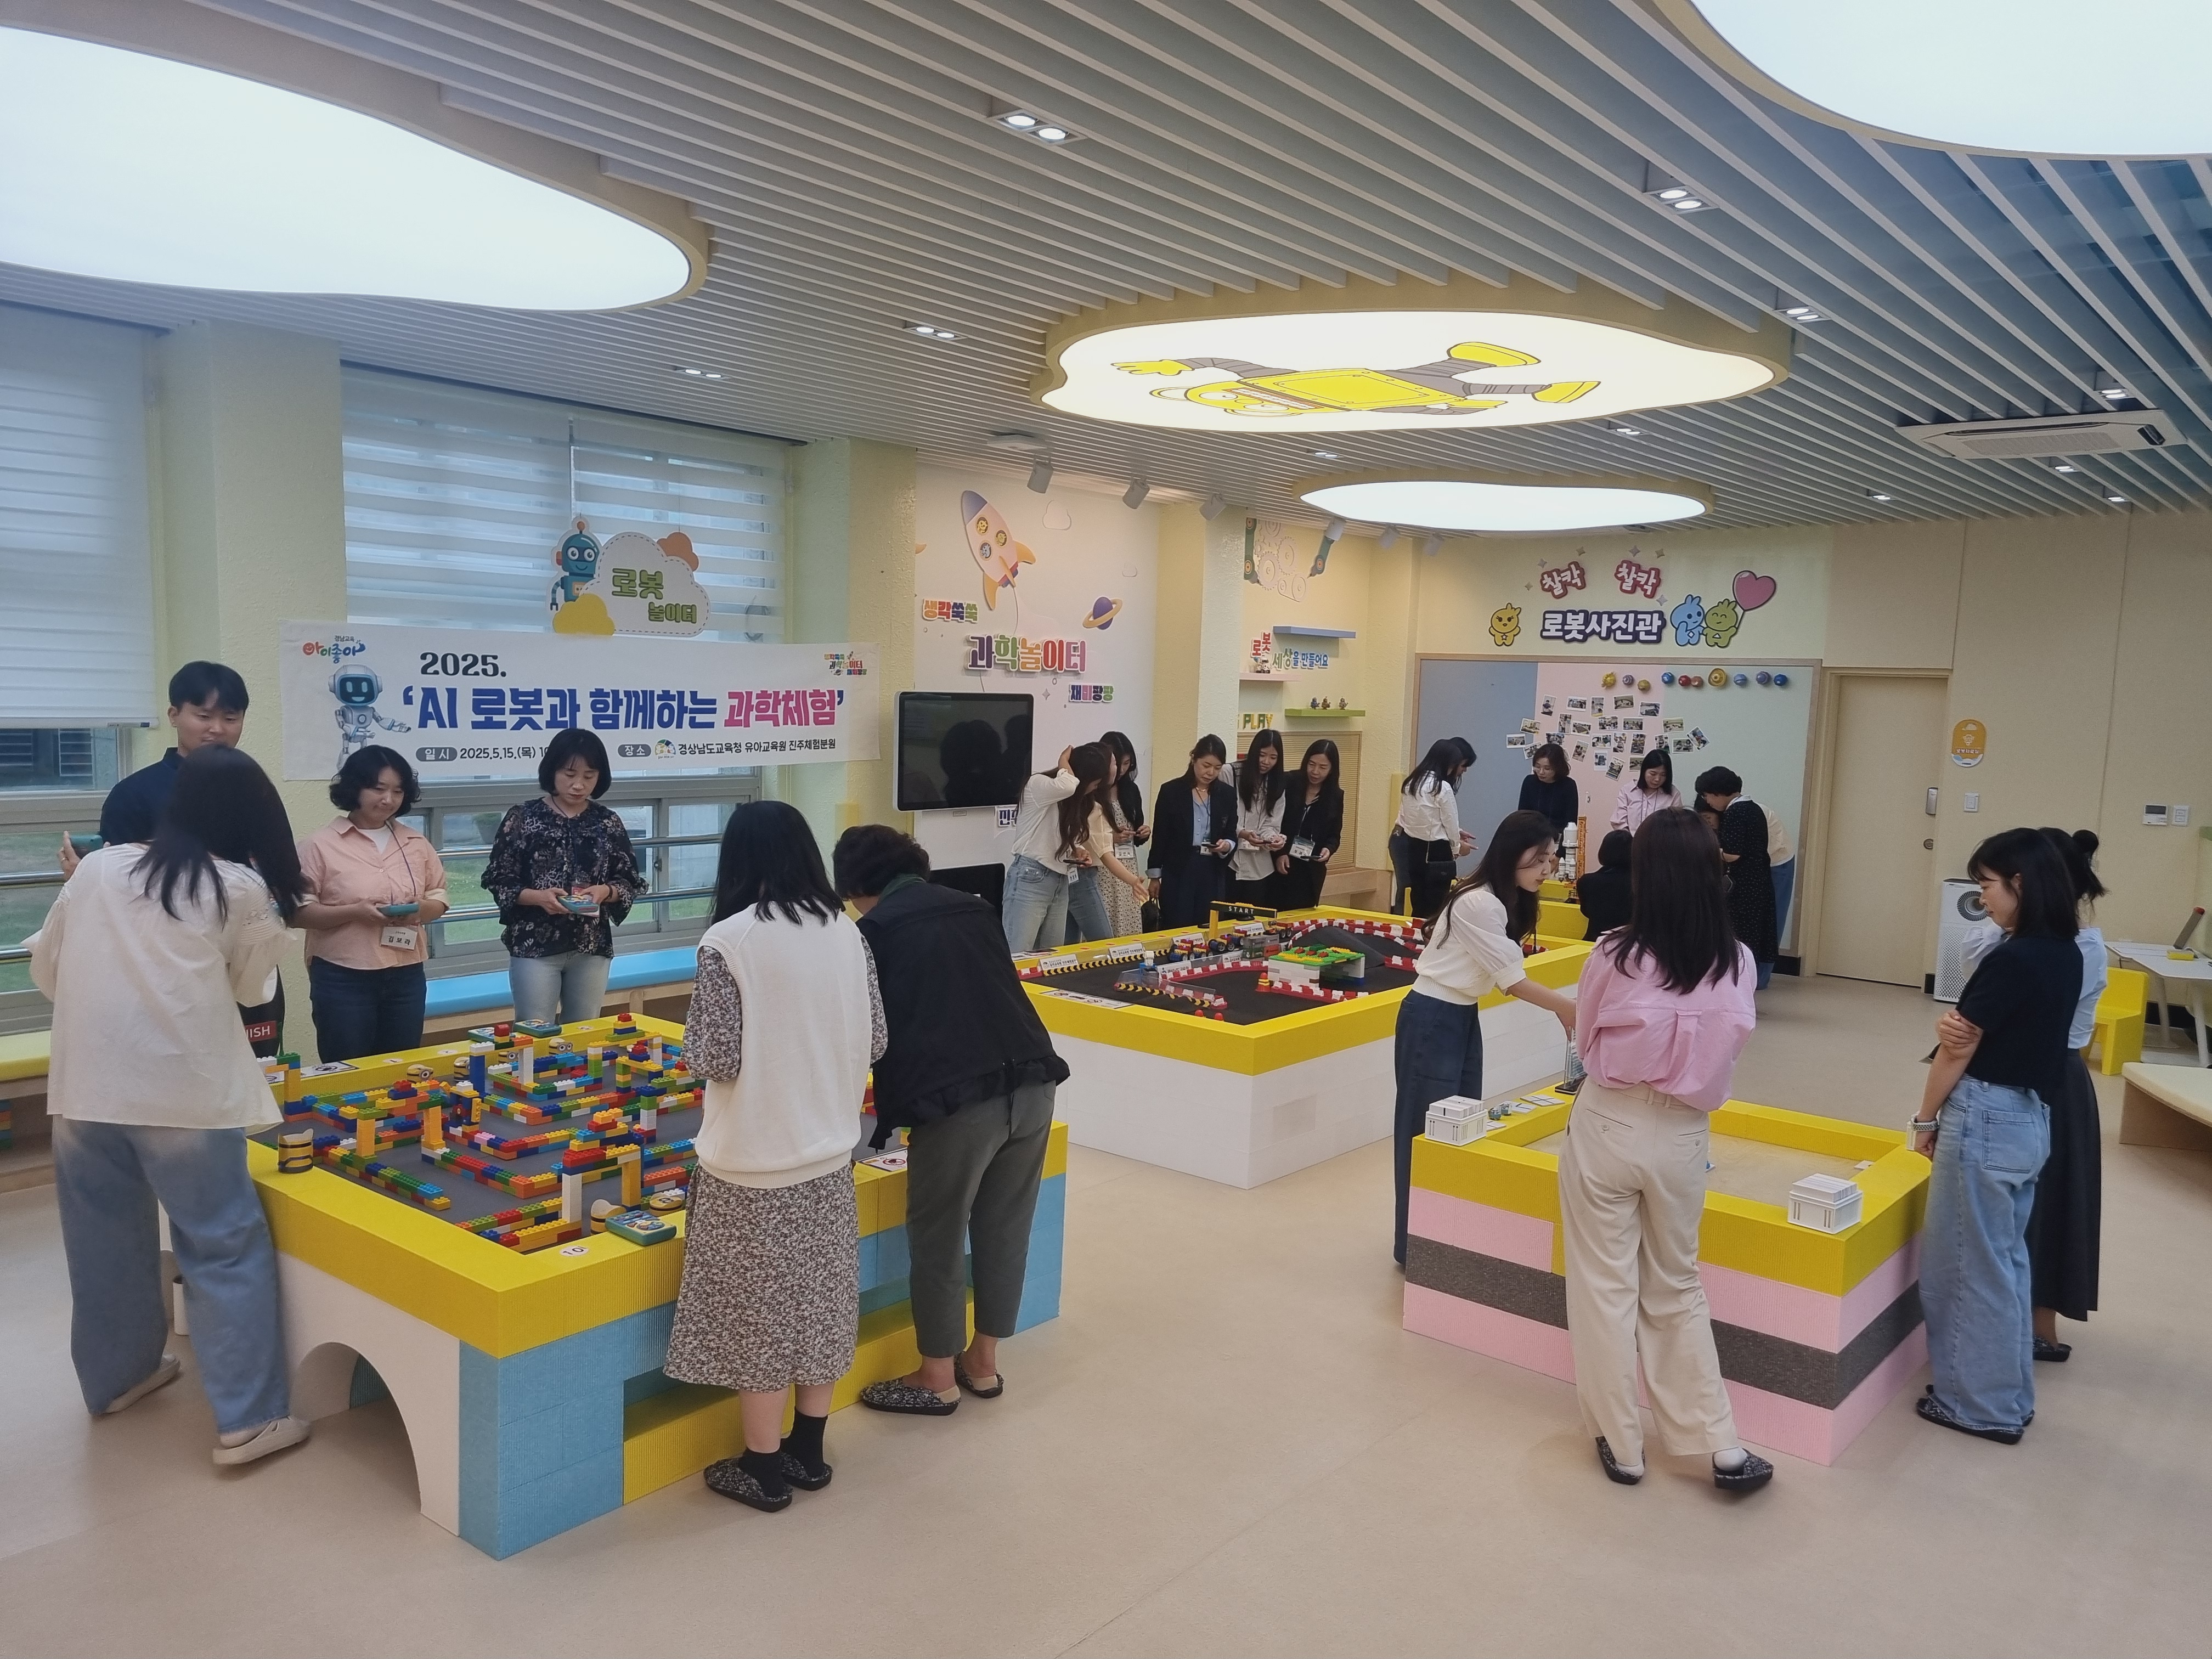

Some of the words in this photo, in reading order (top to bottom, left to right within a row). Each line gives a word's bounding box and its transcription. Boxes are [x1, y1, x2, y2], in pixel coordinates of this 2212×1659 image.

[612, 568, 663, 600] 로봇
[1542, 564, 1580, 595] 찰칵
[1617, 563, 1656, 595] 찰칵
[648, 602, 697, 624] 놀이터
[1542, 612, 1662, 640] 로봇사진관
[302, 641, 366, 664] 아이좋아
[969, 634, 1086, 672] 과학놀이터
[1252, 632, 1271, 656] 로봇
[420, 652, 507, 678] 2025.
[1272, 648, 1300, 669] 세상을
[1301, 652, 1328, 668] 만들어요
[471, 687, 580, 731] 로봇과
[589, 688, 717, 730] 함께하는
[1243, 714, 1273, 729] PLAY
[678, 742, 742, 755] 경상남도교육청
[745, 741, 787, 753] 유아교육원
[789, 738, 836, 751] 진주체험분원
[246, 1025, 270, 1038] ISH
